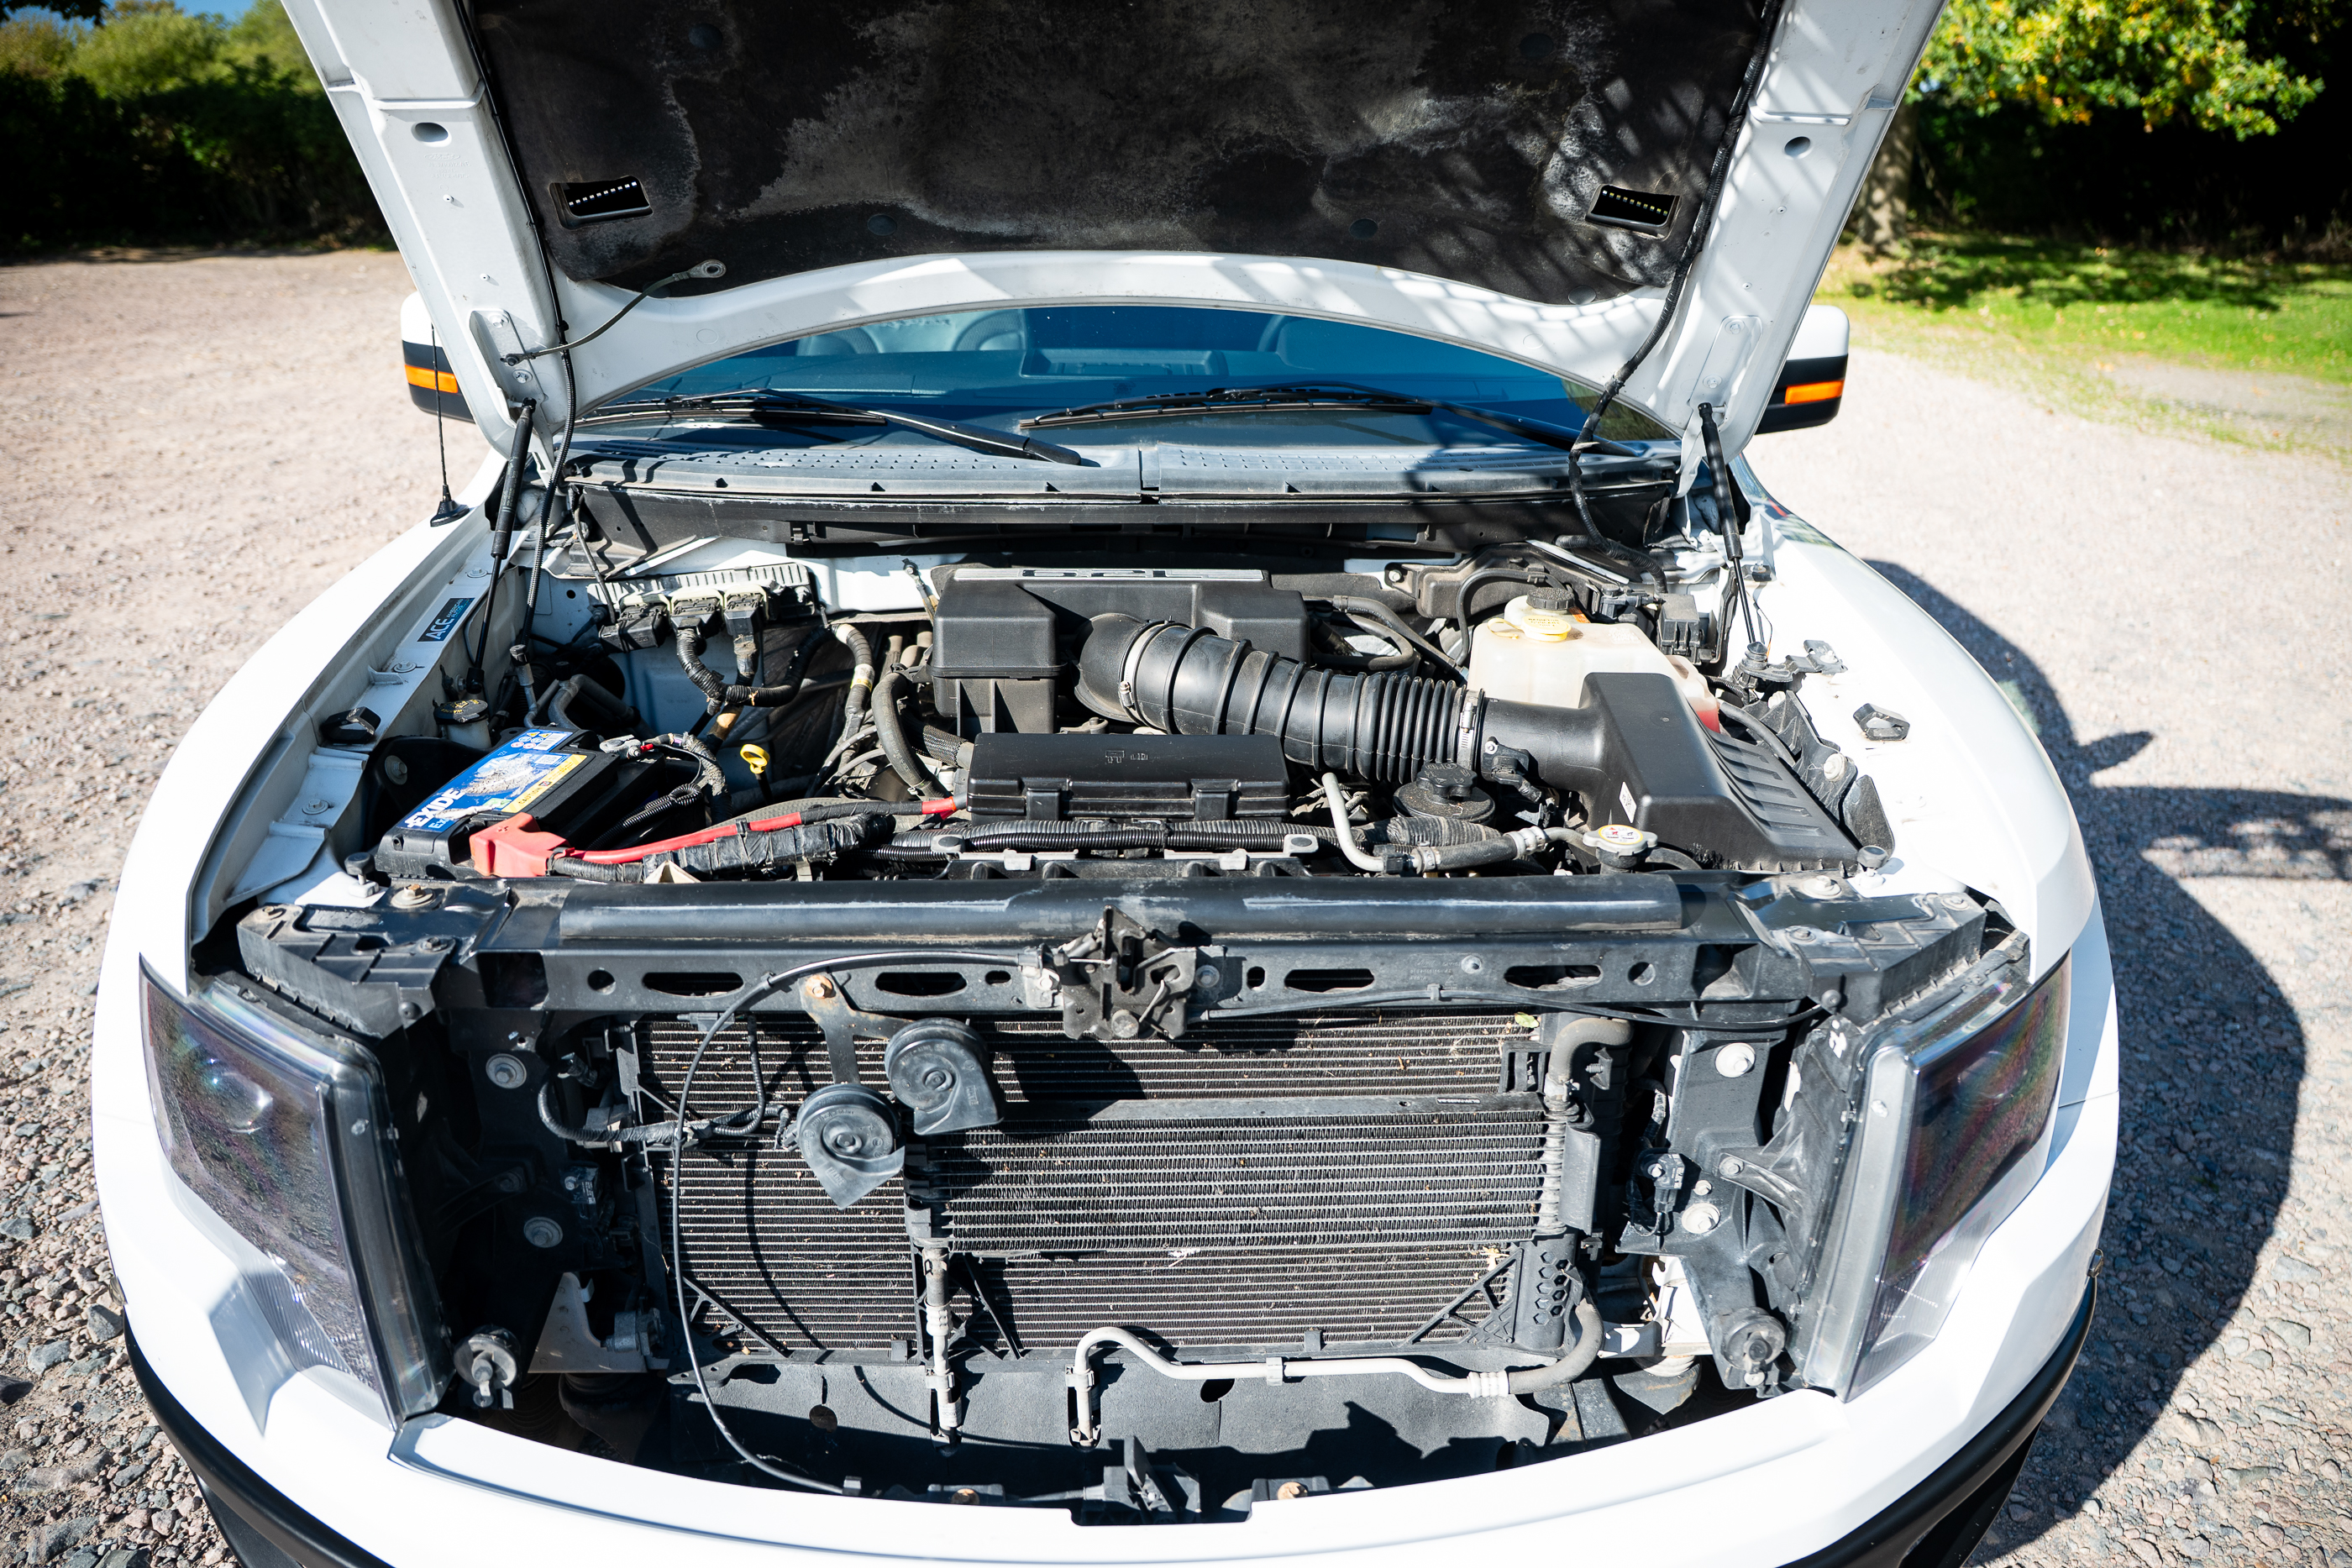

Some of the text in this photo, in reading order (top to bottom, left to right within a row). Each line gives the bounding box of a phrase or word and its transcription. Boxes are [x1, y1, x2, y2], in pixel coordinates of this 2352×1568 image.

[425, 618, 455, 640] ACE
[517, 787, 544, 805] CAUTION
[404, 787, 467, 828] EXIDE
